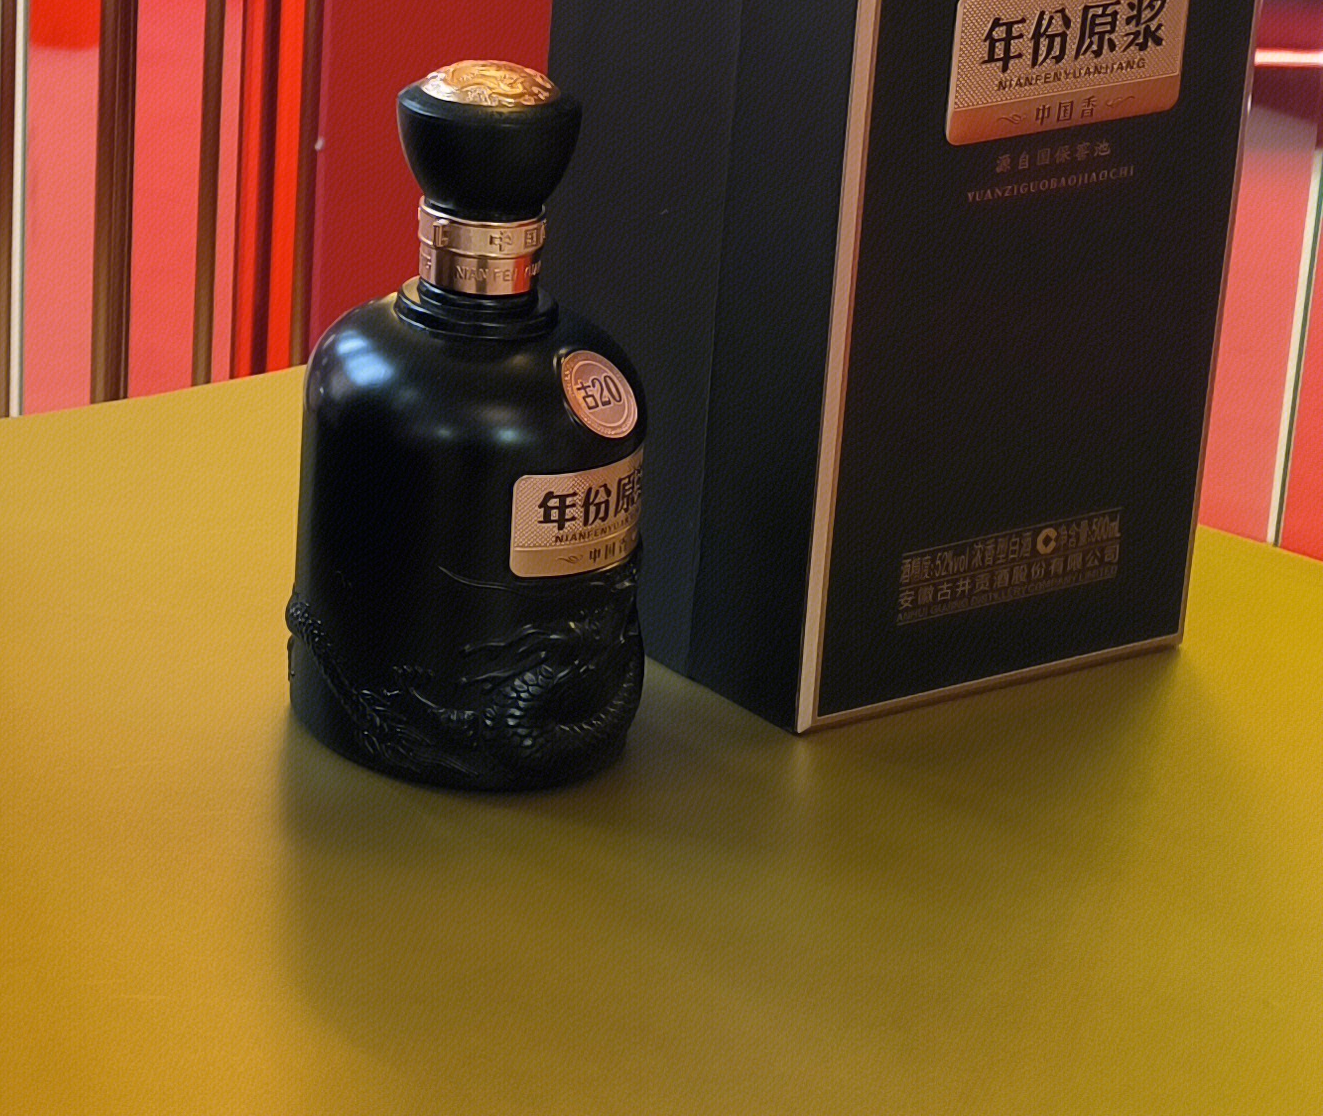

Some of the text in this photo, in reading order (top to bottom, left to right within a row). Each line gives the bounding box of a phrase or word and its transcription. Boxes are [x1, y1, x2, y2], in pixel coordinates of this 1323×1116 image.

[1034, 95, 1098, 126] 中国香
[575, 374, 623, 412] 古20
